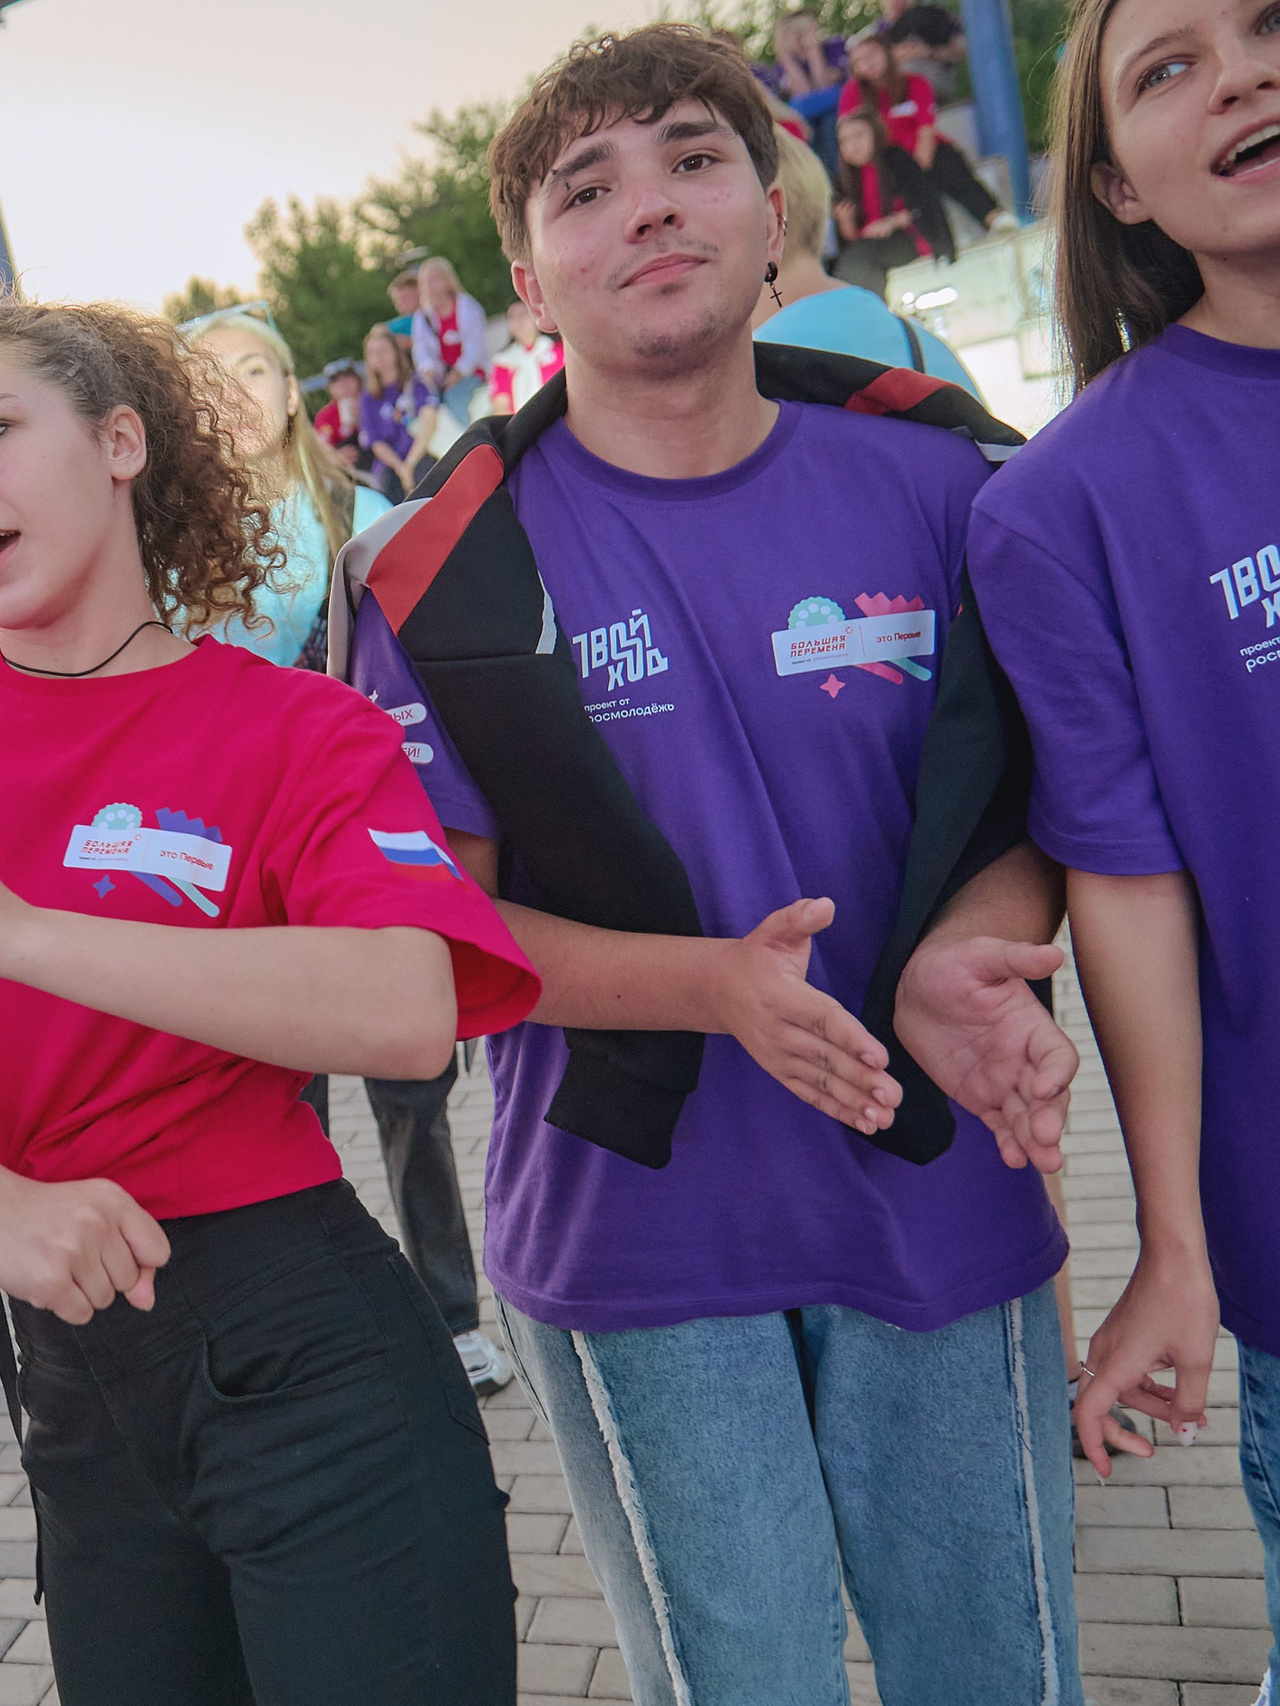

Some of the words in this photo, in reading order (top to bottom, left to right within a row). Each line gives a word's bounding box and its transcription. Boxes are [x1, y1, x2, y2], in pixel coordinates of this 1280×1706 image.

[1209, 544, 1280, 620] ТВО
[791, 635, 846, 650] БОЛЬШАЯ
[876, 635, 893, 643] это
[790, 642, 845, 657] ПЕРЕМЕНА
[584, 700, 617, 713] проект
[619, 698, 630, 706] от
[160, 850, 178, 859] это
